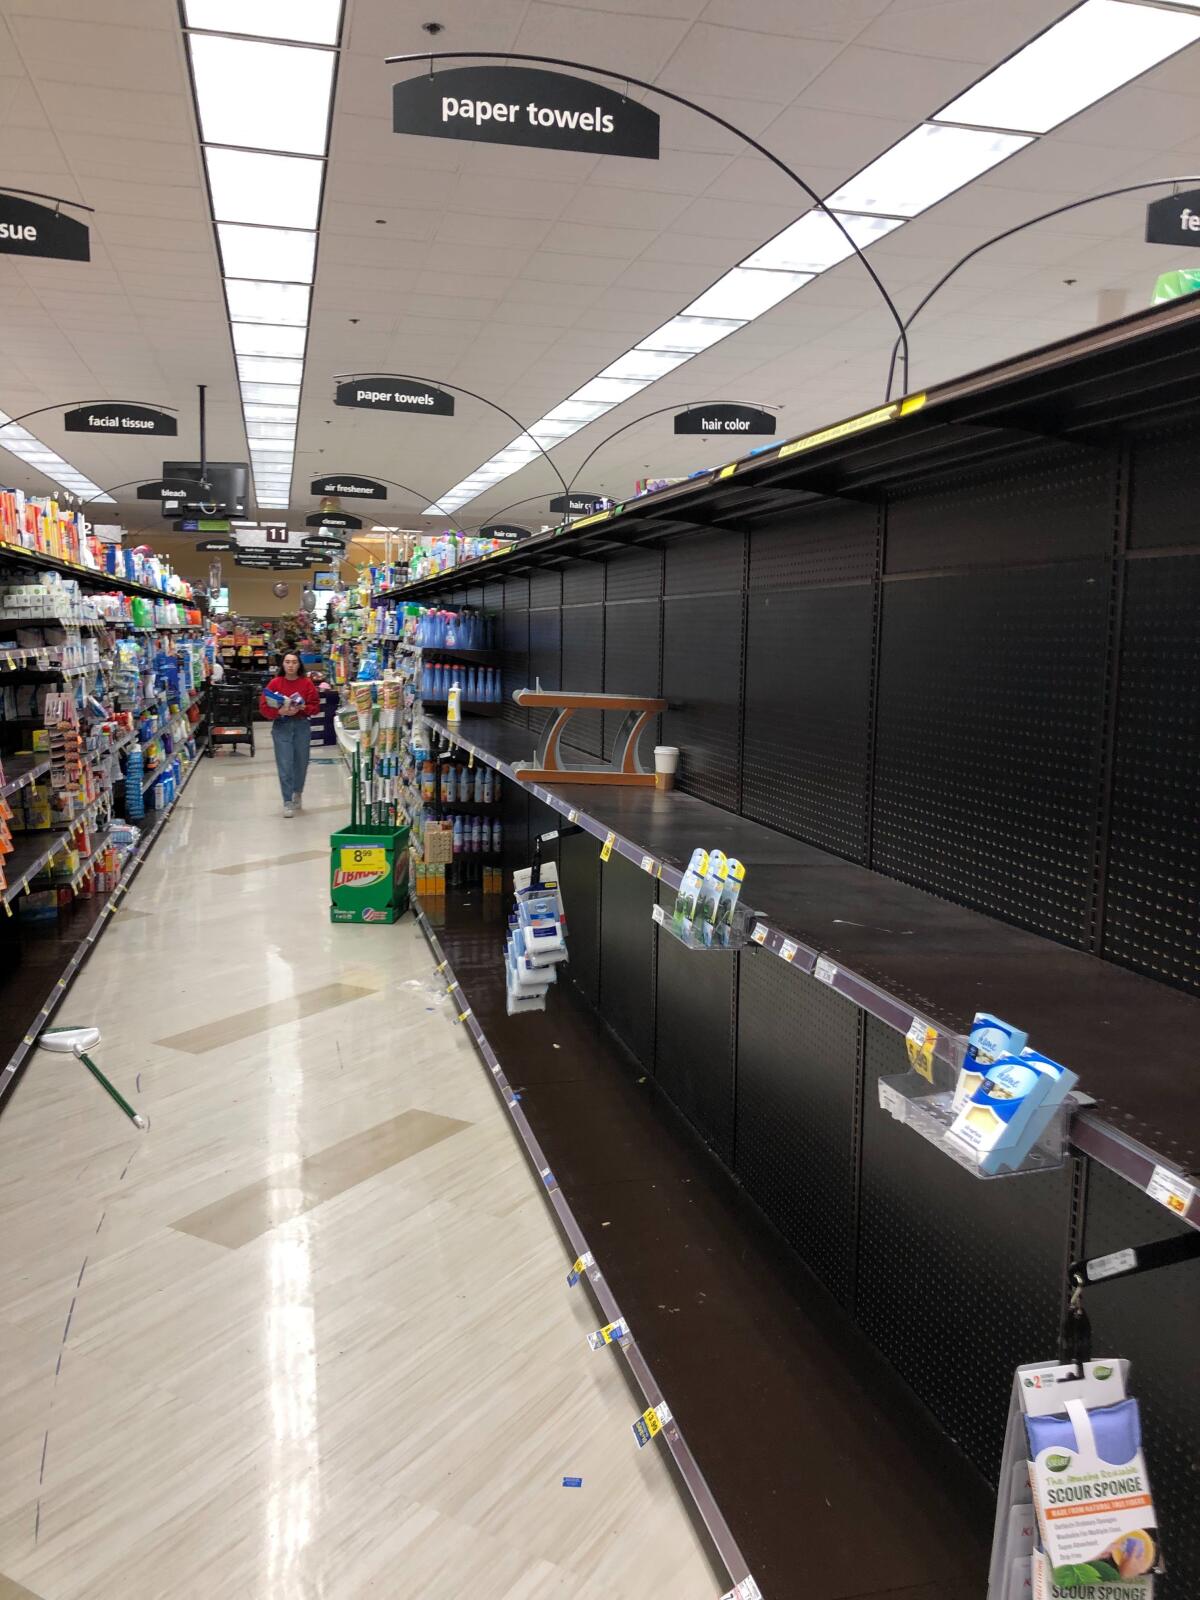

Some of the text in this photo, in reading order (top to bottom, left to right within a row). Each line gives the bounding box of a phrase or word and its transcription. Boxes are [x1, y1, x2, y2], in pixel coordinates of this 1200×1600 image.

[441, 96, 615, 134] paper towels
[356, 391, 434, 405] paper towels
[88, 416, 155, 429] facial tissue
[701, 417, 750, 431] hair color
[161, 489, 187, 497] bleach
[324, 483, 375, 494] air freshener
[569, 501, 584, 509] hair
[322, 518, 346, 526] cleaners
[270, 528, 286, 540] 11
[1033, 1375, 1041, 1389] 2
[1047, 1477, 1142, 1504] SCOUR SPONGE
[1051, 1585, 1148, 1600] SCOUR SPONGE
